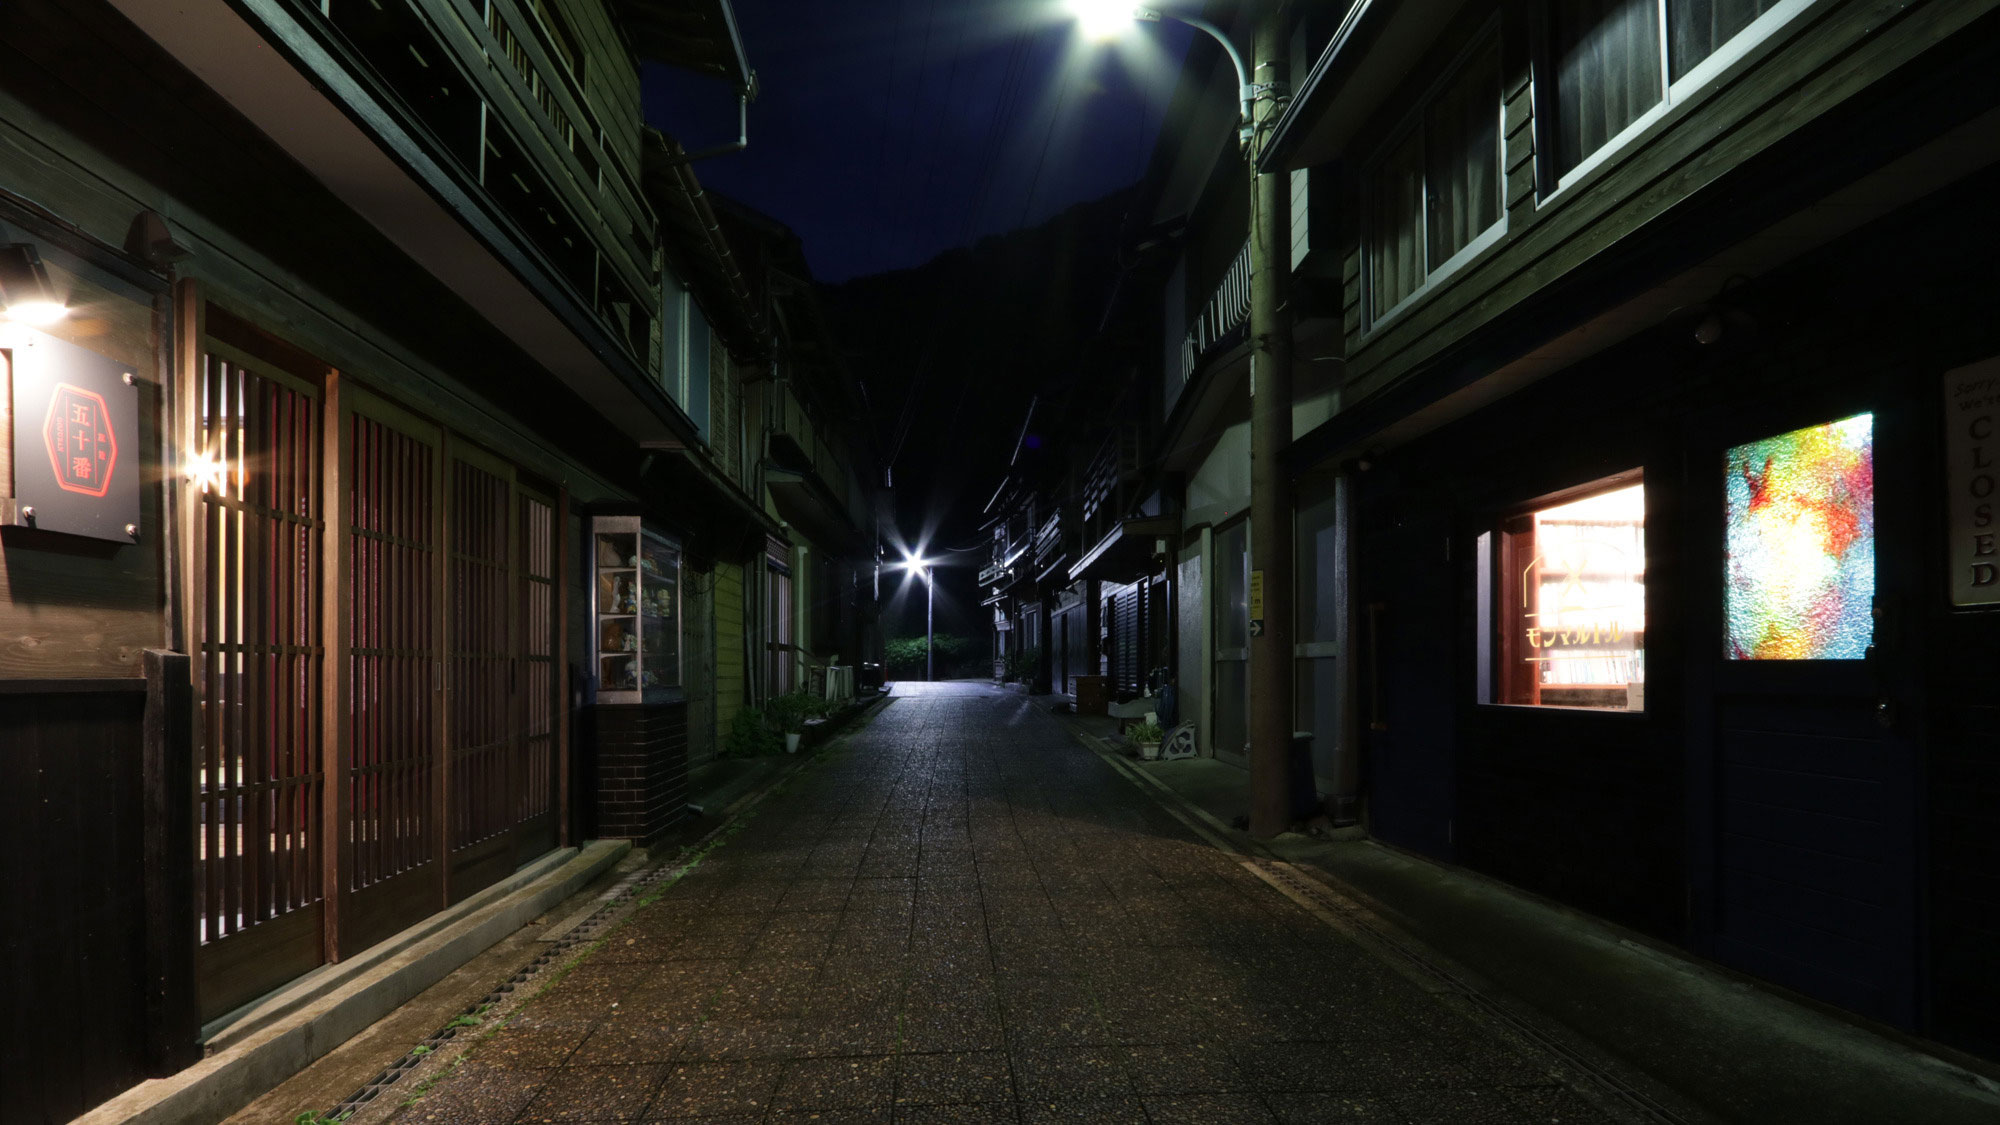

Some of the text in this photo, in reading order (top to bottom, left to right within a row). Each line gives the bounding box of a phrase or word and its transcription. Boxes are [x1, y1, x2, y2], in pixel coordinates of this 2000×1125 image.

[72, 404, 91, 479] 五十番
[1969, 416, 1997, 587] CLOSED
[1526, 621, 1623, 647] モンマルトル
